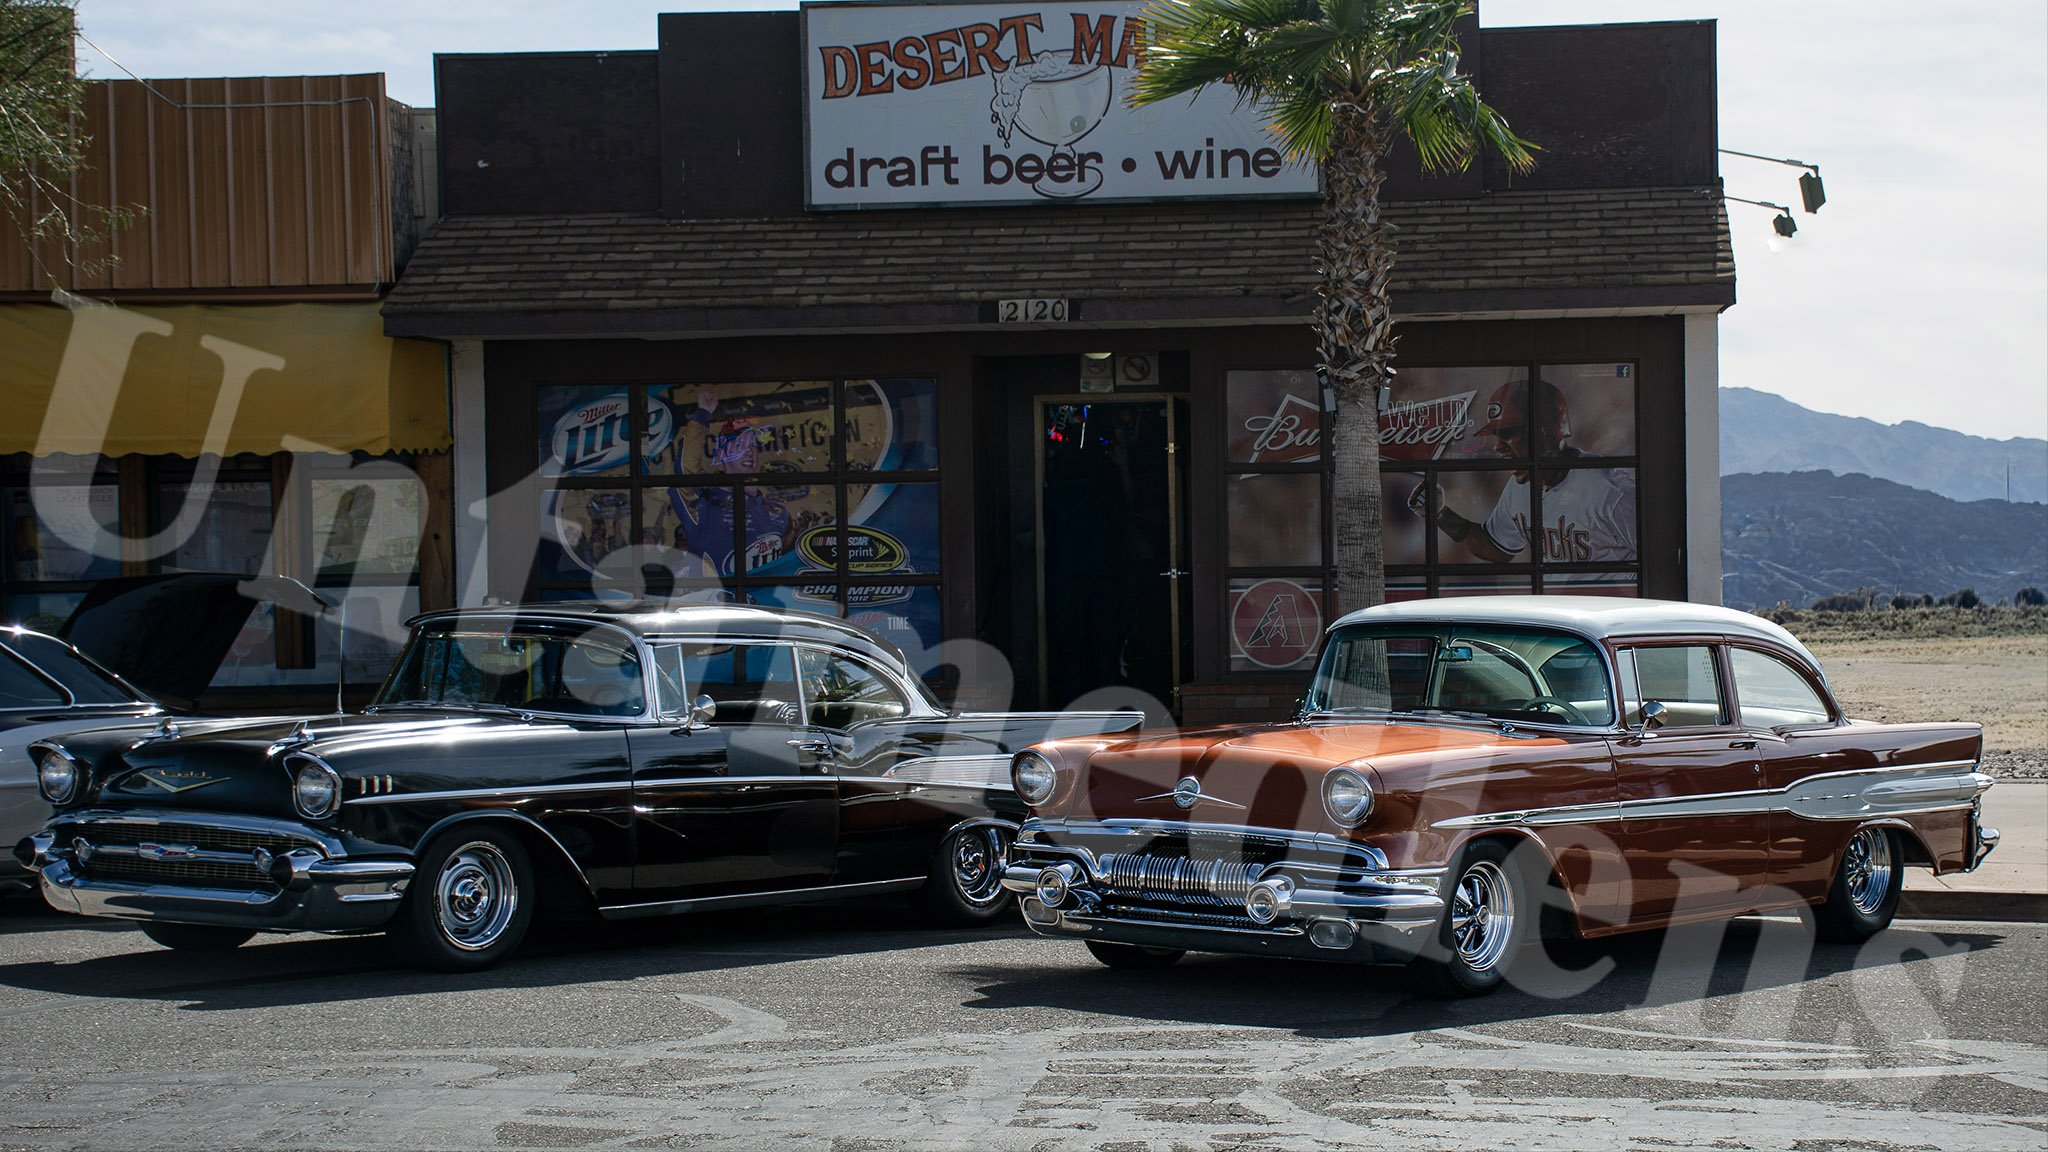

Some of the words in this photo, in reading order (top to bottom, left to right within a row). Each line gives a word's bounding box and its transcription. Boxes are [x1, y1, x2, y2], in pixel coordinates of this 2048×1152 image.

[819, 13, 1043, 99] DESERT
[824, 146, 960, 189] draft
[983, 144, 1102, 186] beer
[1154, 138, 1282, 181] wine
[1005, 300, 1065, 322] 2120
[577, 403, 622, 424] Miller
[825, 536, 869, 547] NASCAR
[831, 547, 874, 559] Sprint
[802, 584, 905, 595] CHAMPION
[887, 616, 910, 630] TIME
